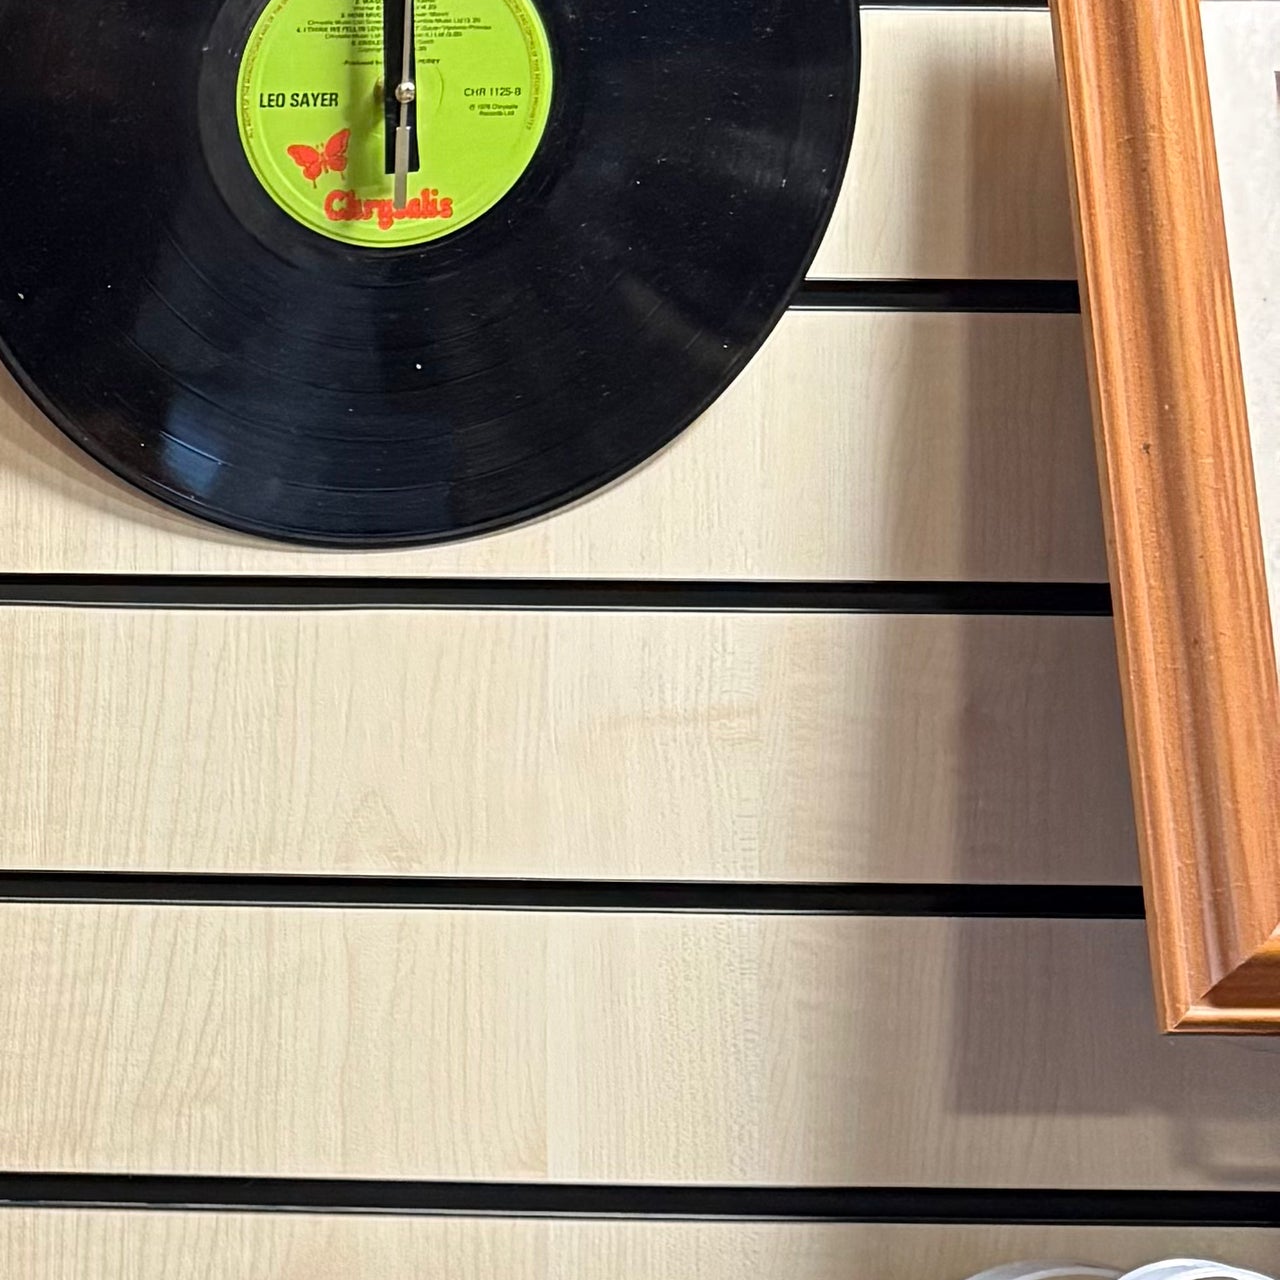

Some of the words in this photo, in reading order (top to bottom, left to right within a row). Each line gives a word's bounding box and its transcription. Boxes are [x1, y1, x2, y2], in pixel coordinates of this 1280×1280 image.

[464, 87, 487, 97] CHR
[259, 93, 286, 108] LEO
[289, 92, 339, 108] SAYER
